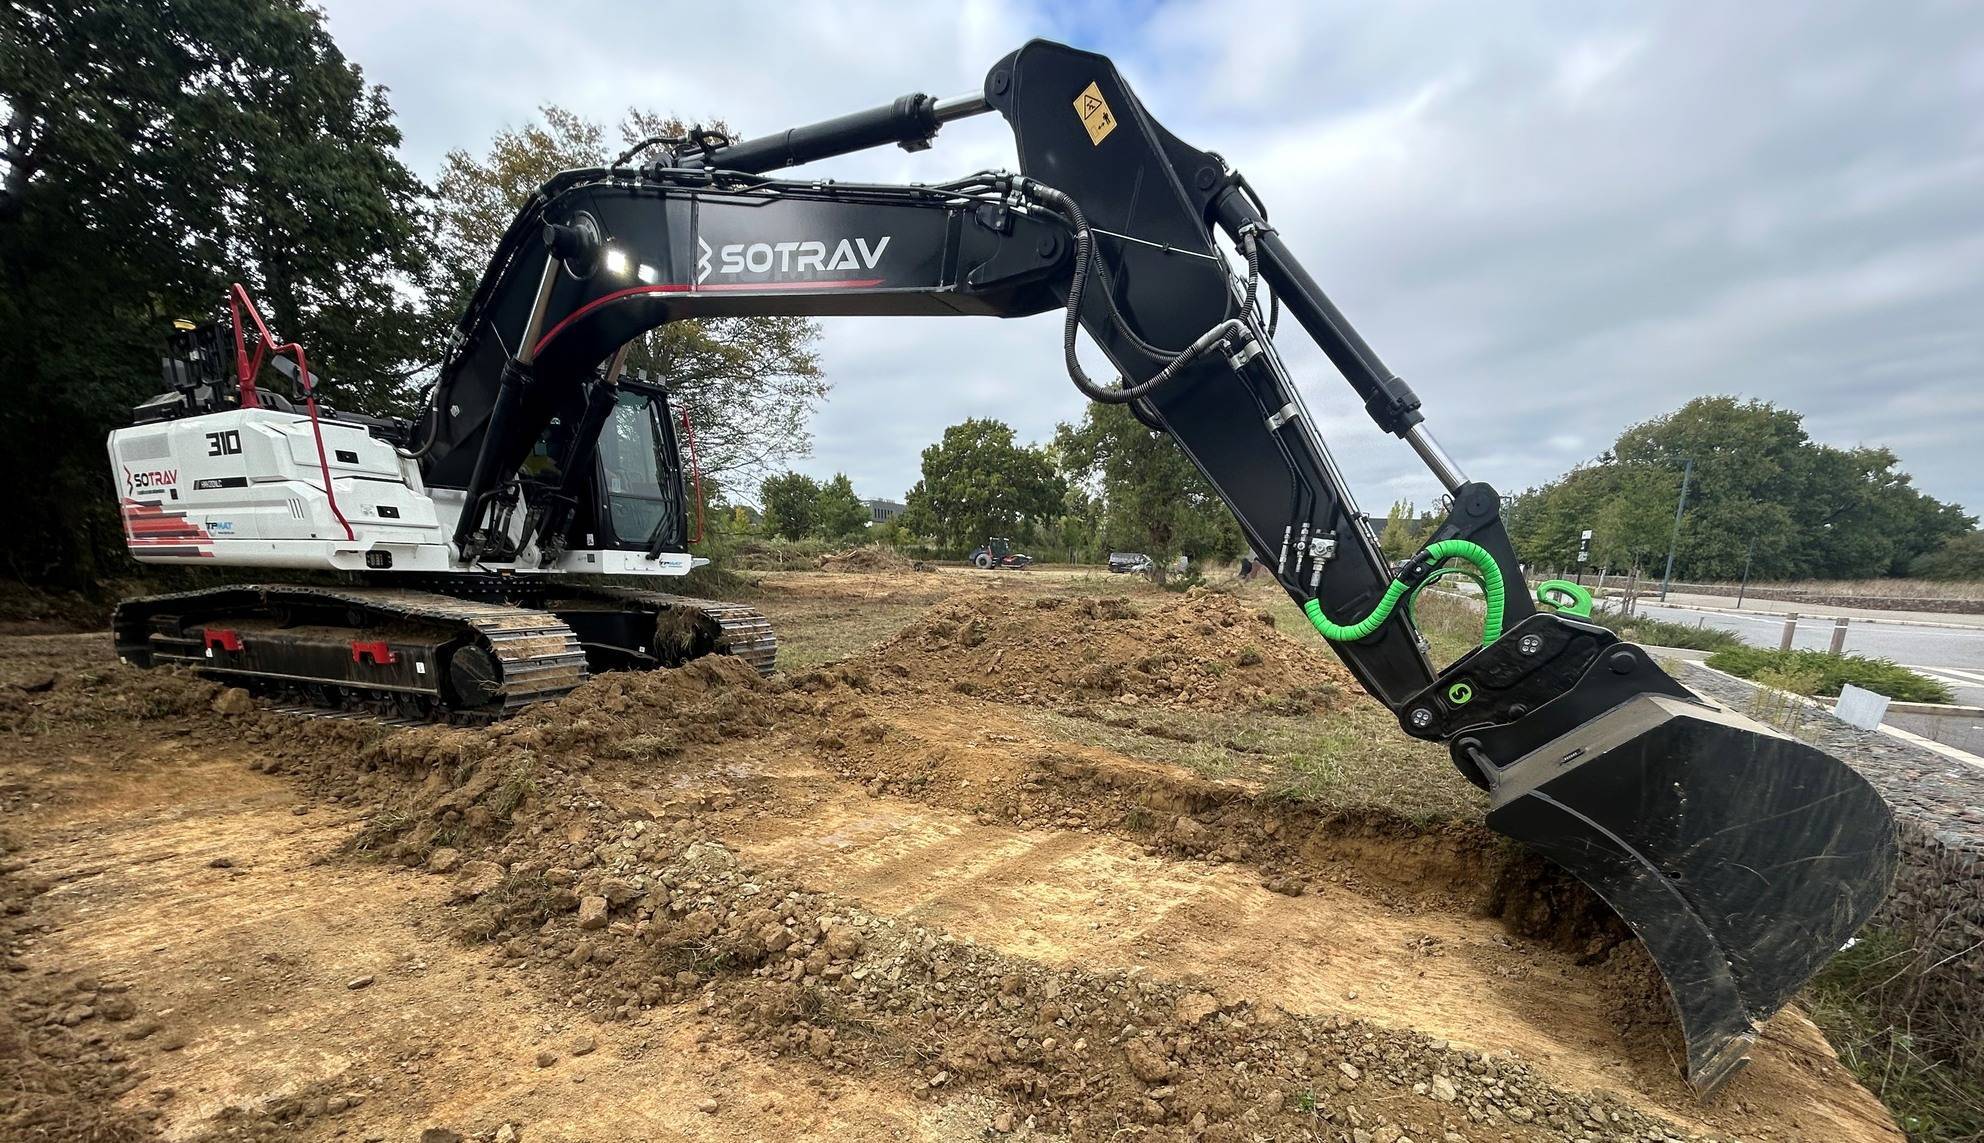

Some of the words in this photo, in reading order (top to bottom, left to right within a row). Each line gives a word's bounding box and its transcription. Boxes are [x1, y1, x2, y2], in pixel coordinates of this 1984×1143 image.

[720, 236, 891, 274] SOTRAV
[206, 429, 243, 457] 310
[133, 469, 177, 488] SOTRAV
